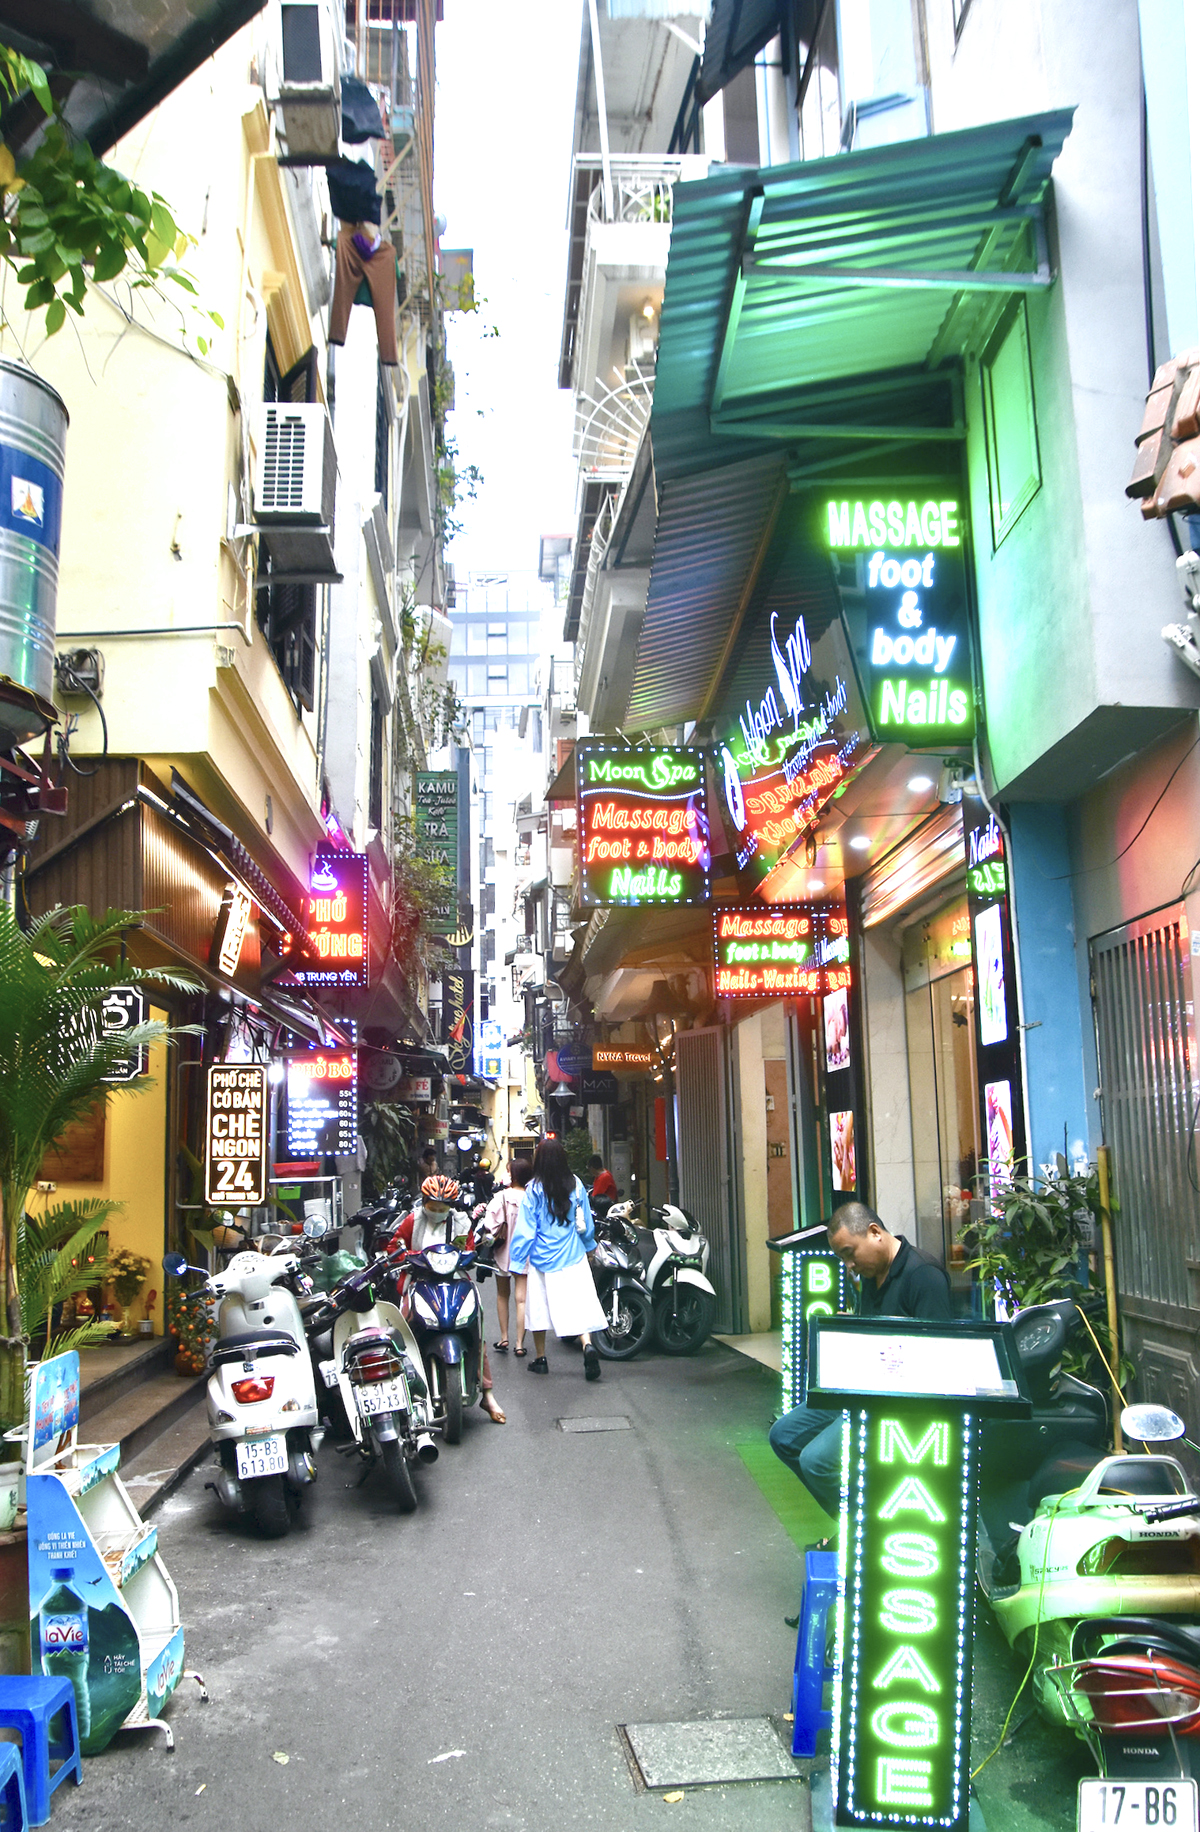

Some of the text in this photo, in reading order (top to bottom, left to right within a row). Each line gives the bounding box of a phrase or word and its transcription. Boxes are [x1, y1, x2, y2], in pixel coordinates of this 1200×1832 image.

[827, 500, 960, 547] MASSAGE
[868, 550, 936, 589] foot
[896, 590, 923, 629] &
[871, 627, 957, 673] body
[879, 678, 968, 725] Nails
[589, 755, 697, 789] Moon Spa
[418, 782, 455, 794] KAMU
[424, 816, 449, 837] TRÀ
[591, 802, 697, 835] Massage
[587, 836, 632, 863] foot
[636, 841, 650, 858] &
[652, 836, 703, 863] body
[968, 813, 1000, 870] Nails
[610, 866, 682, 896] Nails
[721, 915, 809, 939] Massage
[726, 941, 759, 965] foot
[771, 941, 808, 964] body
[305, 972, 338, 982] TRUNG
[338, 969, 358, 982] YÊN
[719, 966, 818, 991] Nails-Waxing
[291, 1056, 352, 1078] PHỞ BÒ
[624, 1051, 652, 1063] Travel
[213, 1070, 261, 1087] PHỐ CHÈ
[213, 1088, 261, 1108] CÓ BÁN
[212, 1109, 261, 1138] CHÈ
[212, 1138, 260, 1157] NGON
[216, 1160, 254, 1191] 24
[363, 1393, 400, 1413] 557-X3
[245, 1441, 279, 1459] 15-B3
[241, 1455, 285, 1476] 613.80
[1138, 1530, 1180, 1538] HONDA
[870, 1418, 950, 1807] MASSAGE
[45, 1626, 84, 1643] laVie
[157, 1659, 175, 1690] laVie
[1123, 1747, 1159, 1756] HONDA
[1098, 1786, 1177, 1826] 17-B6
